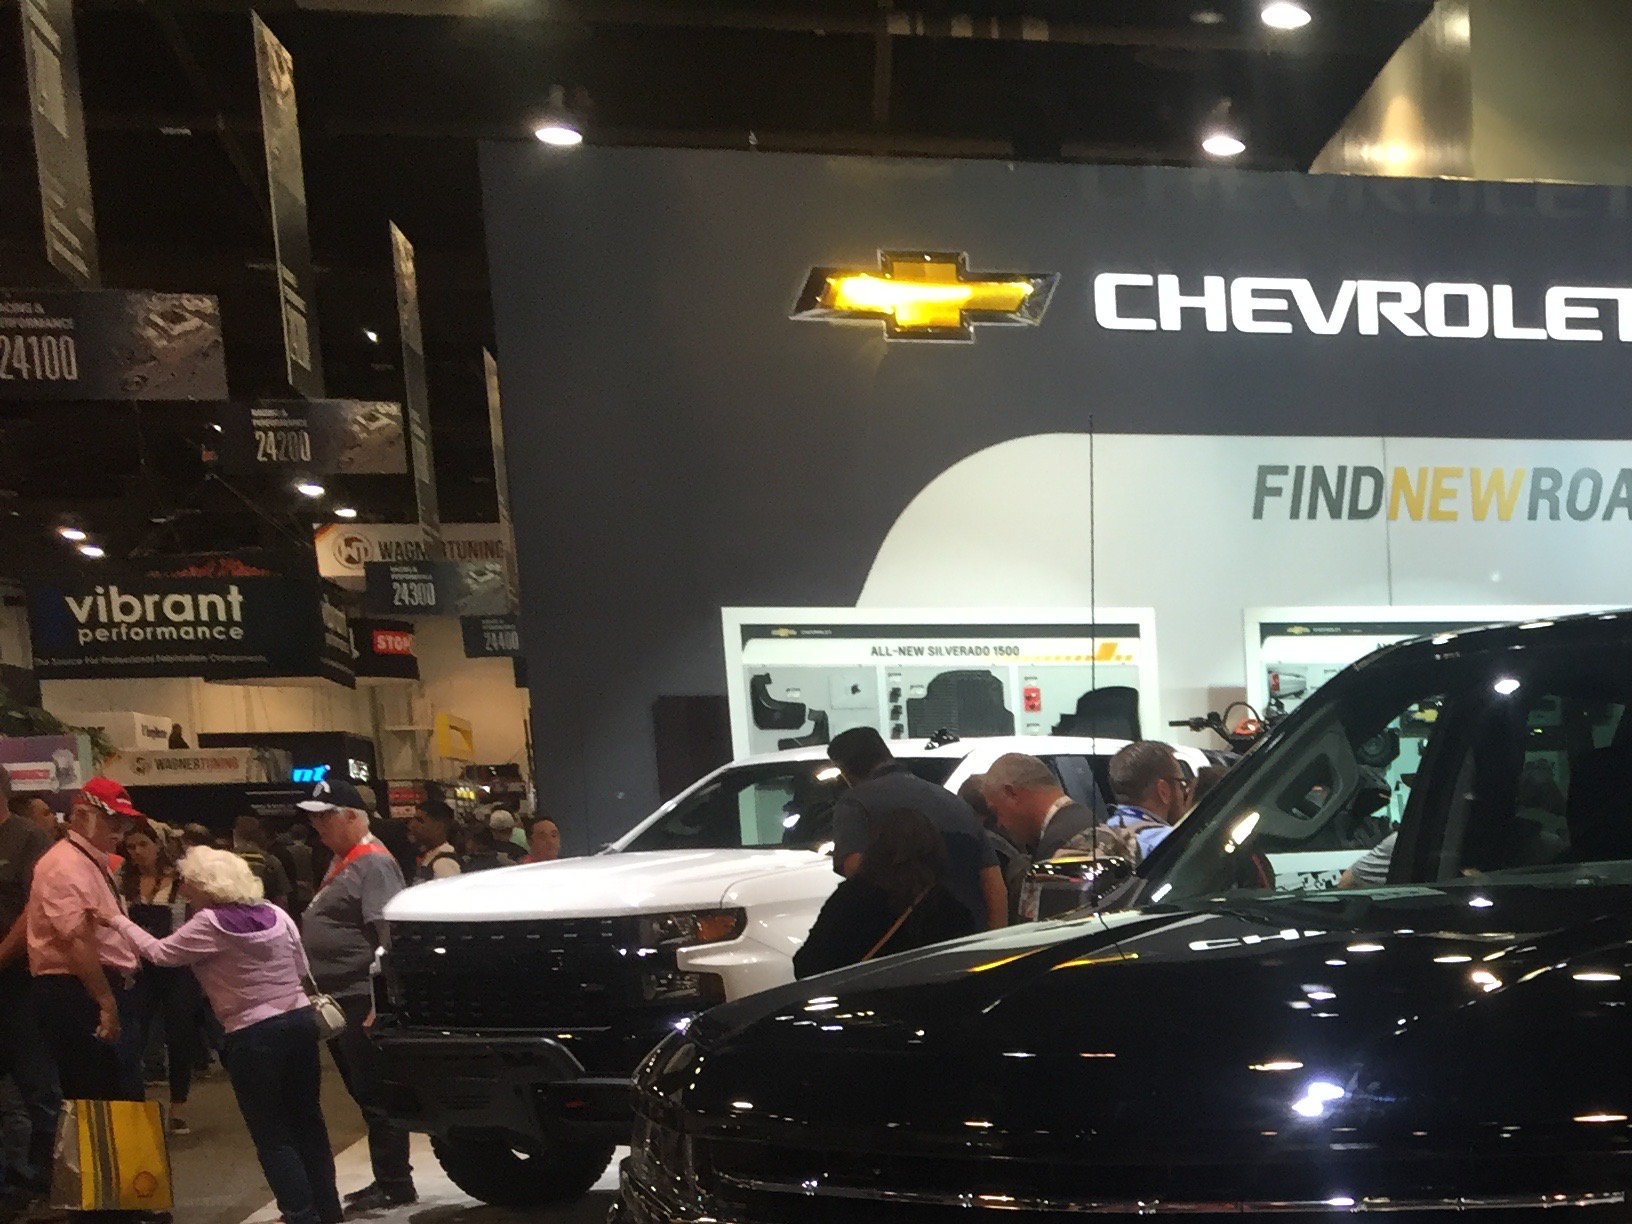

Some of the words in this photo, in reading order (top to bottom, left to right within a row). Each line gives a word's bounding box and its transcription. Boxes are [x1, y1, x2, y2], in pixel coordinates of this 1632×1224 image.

[254, 430, 312, 462] 24200
[64, 584, 244, 624] vibrant
[77, 623, 244, 646] performance
[871, 645, 925, 657] ALL-NEW
[927, 645, 991, 657] SILVERADO
[993, 645, 1020, 657] 1500
